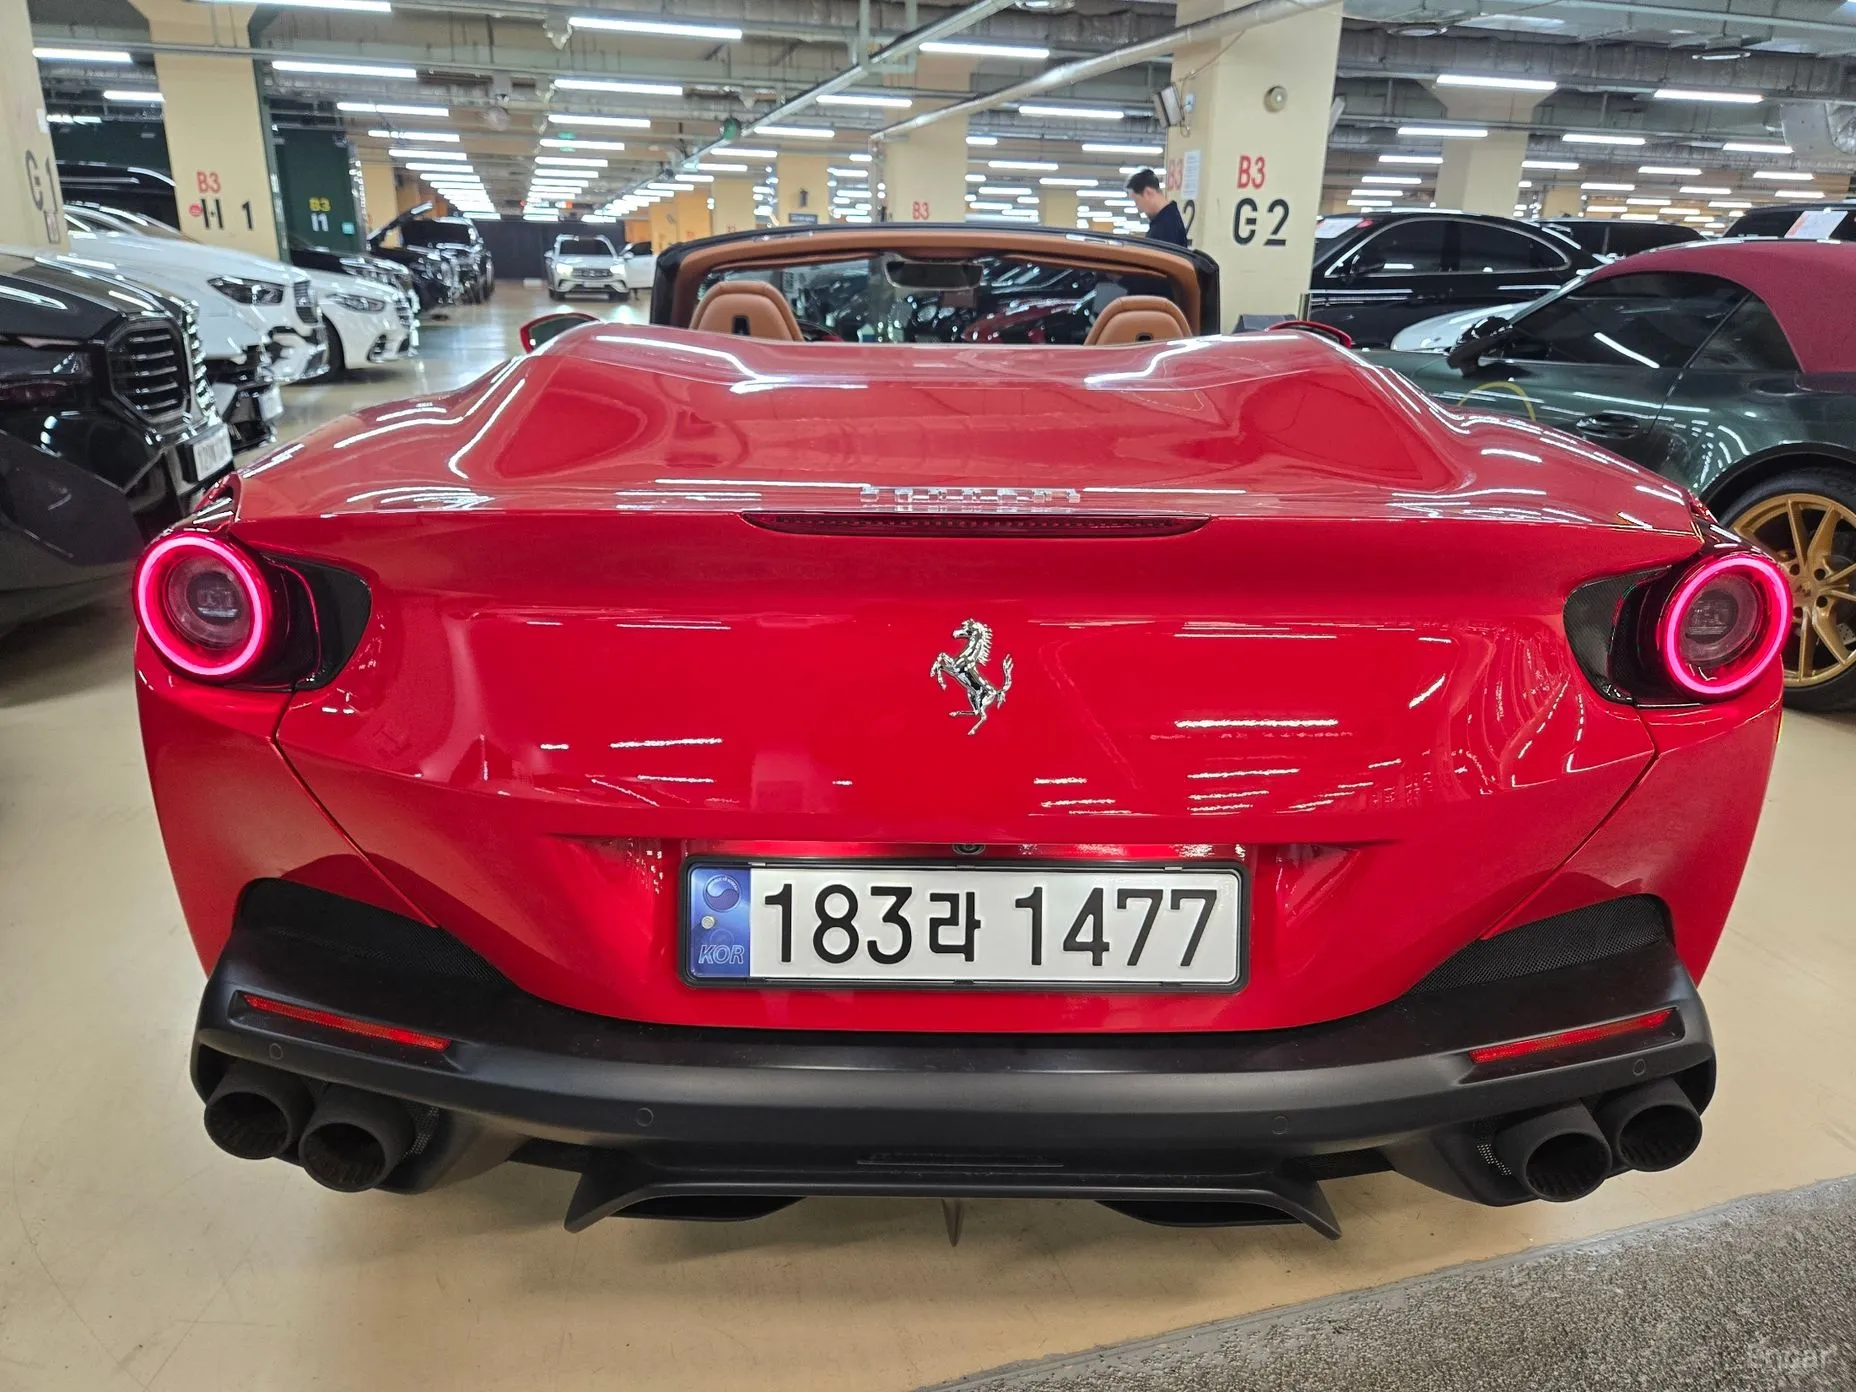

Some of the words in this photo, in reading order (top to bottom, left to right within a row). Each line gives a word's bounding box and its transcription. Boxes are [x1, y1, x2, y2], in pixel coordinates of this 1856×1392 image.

[196, 171, 221, 193] B3
[1237, 155, 1265, 189] B3
[912, 201, 929, 220] B3
[763, 883, 982, 965] 183라
[1014, 886, 1219, 967] 1477
[698, 944, 744, 965] KOR
